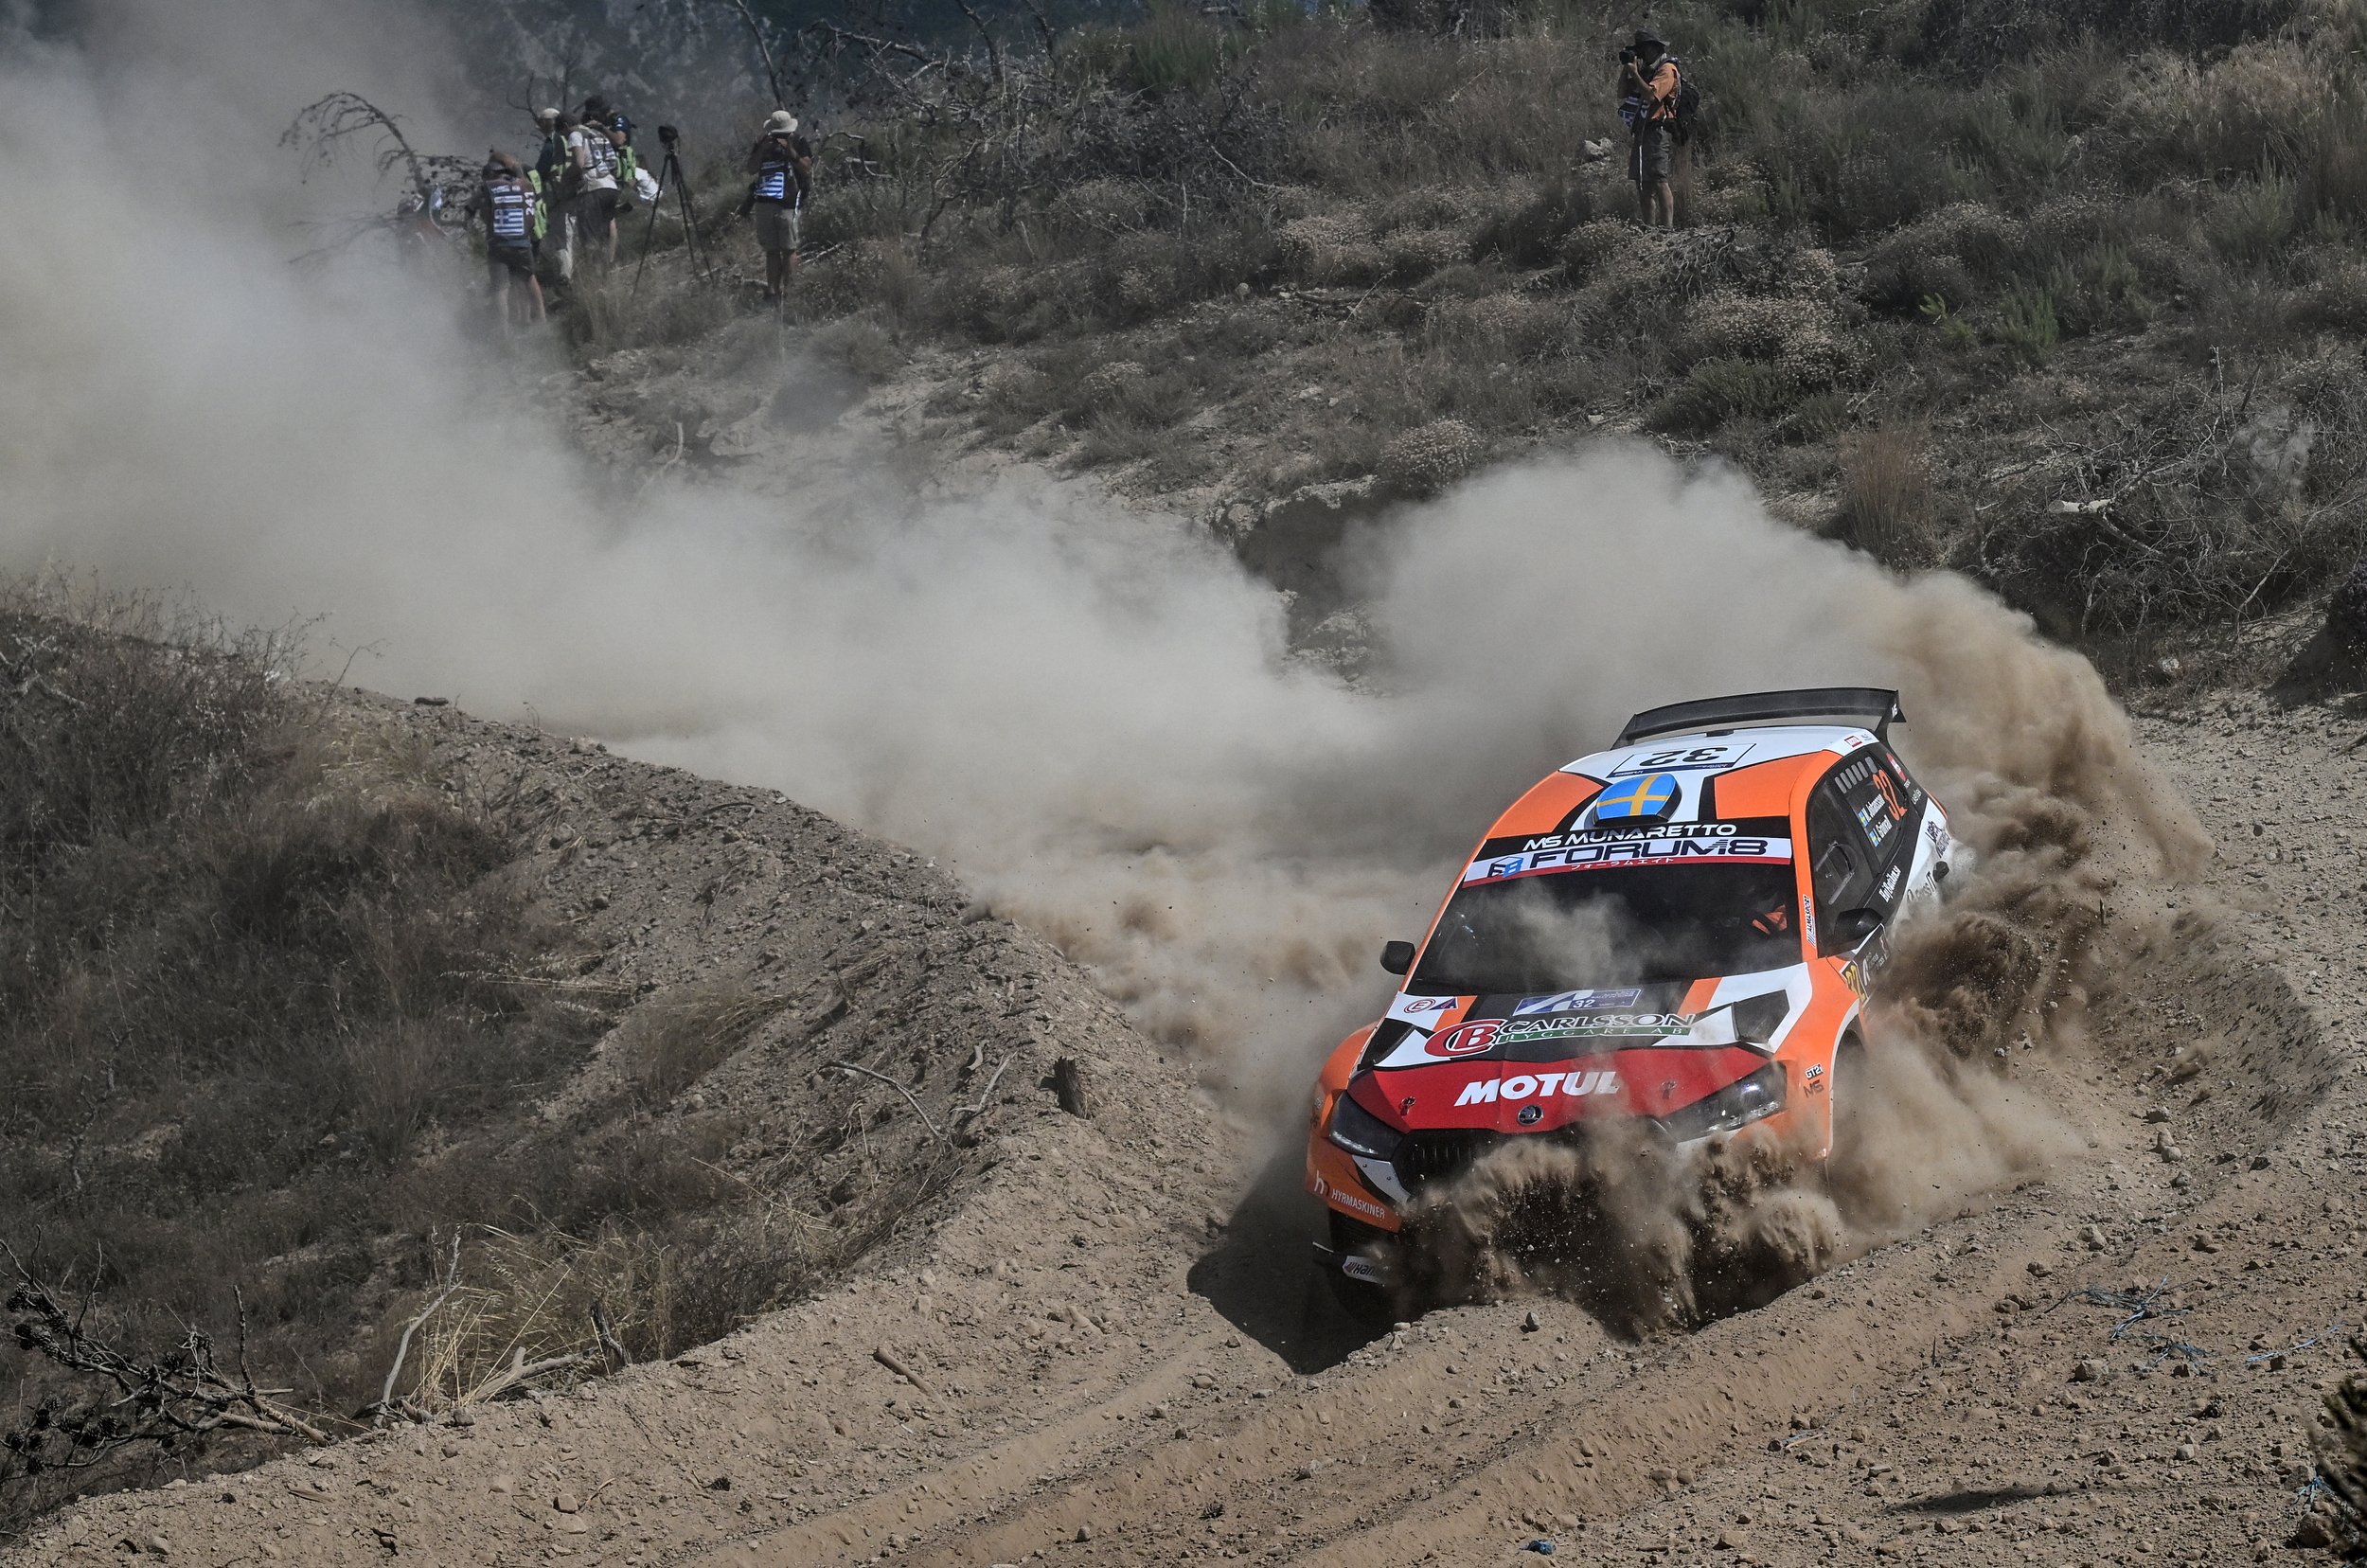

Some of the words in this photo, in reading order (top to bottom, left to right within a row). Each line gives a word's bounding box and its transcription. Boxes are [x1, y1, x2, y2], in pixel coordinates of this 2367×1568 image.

[524, 191, 535, 216] 241
[1639, 746, 1729, 767] 32
[1873, 769, 1907, 821] 32
[1522, 834, 1564, 852] MS
[1564, 824, 1737, 846] MUNARETTO
[1529, 839, 1769, 869] FORUM8
[1571, 857, 1675, 870] フォーラムエイト
[1573, 999, 1595, 1008] 32
[1500, 1013, 1696, 1035] CARLSSON
[1453, 1071, 1620, 1107] MOTUL
[1331, 1188, 1386, 1219] HYRMASKINER
